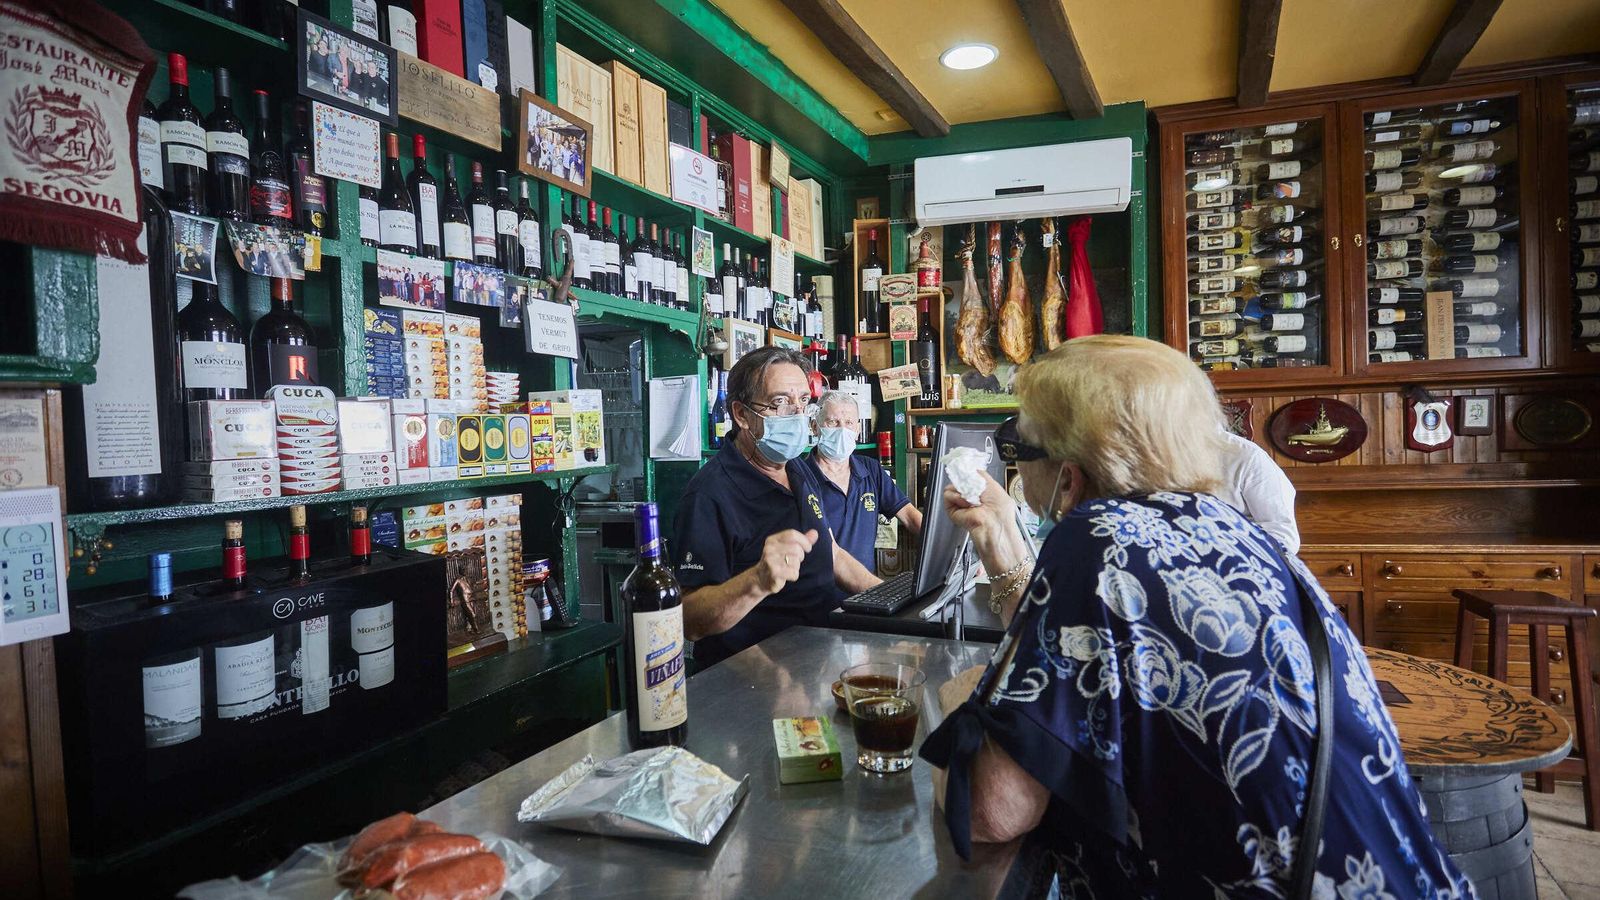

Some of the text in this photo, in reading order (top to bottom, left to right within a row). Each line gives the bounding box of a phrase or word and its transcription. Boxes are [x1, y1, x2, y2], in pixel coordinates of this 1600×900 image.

[402, 58, 475, 100] JOSELITO
[4, 177, 123, 215] SEGOVIA
[537, 313, 568, 324] TENEMOS
[540, 327, 567, 338] VERMUT
[539, 342, 548, 350] DE
[283, 388, 324, 398] CUCA
[23, 568, 44, 582] 28
[24, 584, 45, 598] 61
[26, 598, 46, 614] 31
[298, 592, 325, 606] CAVE
